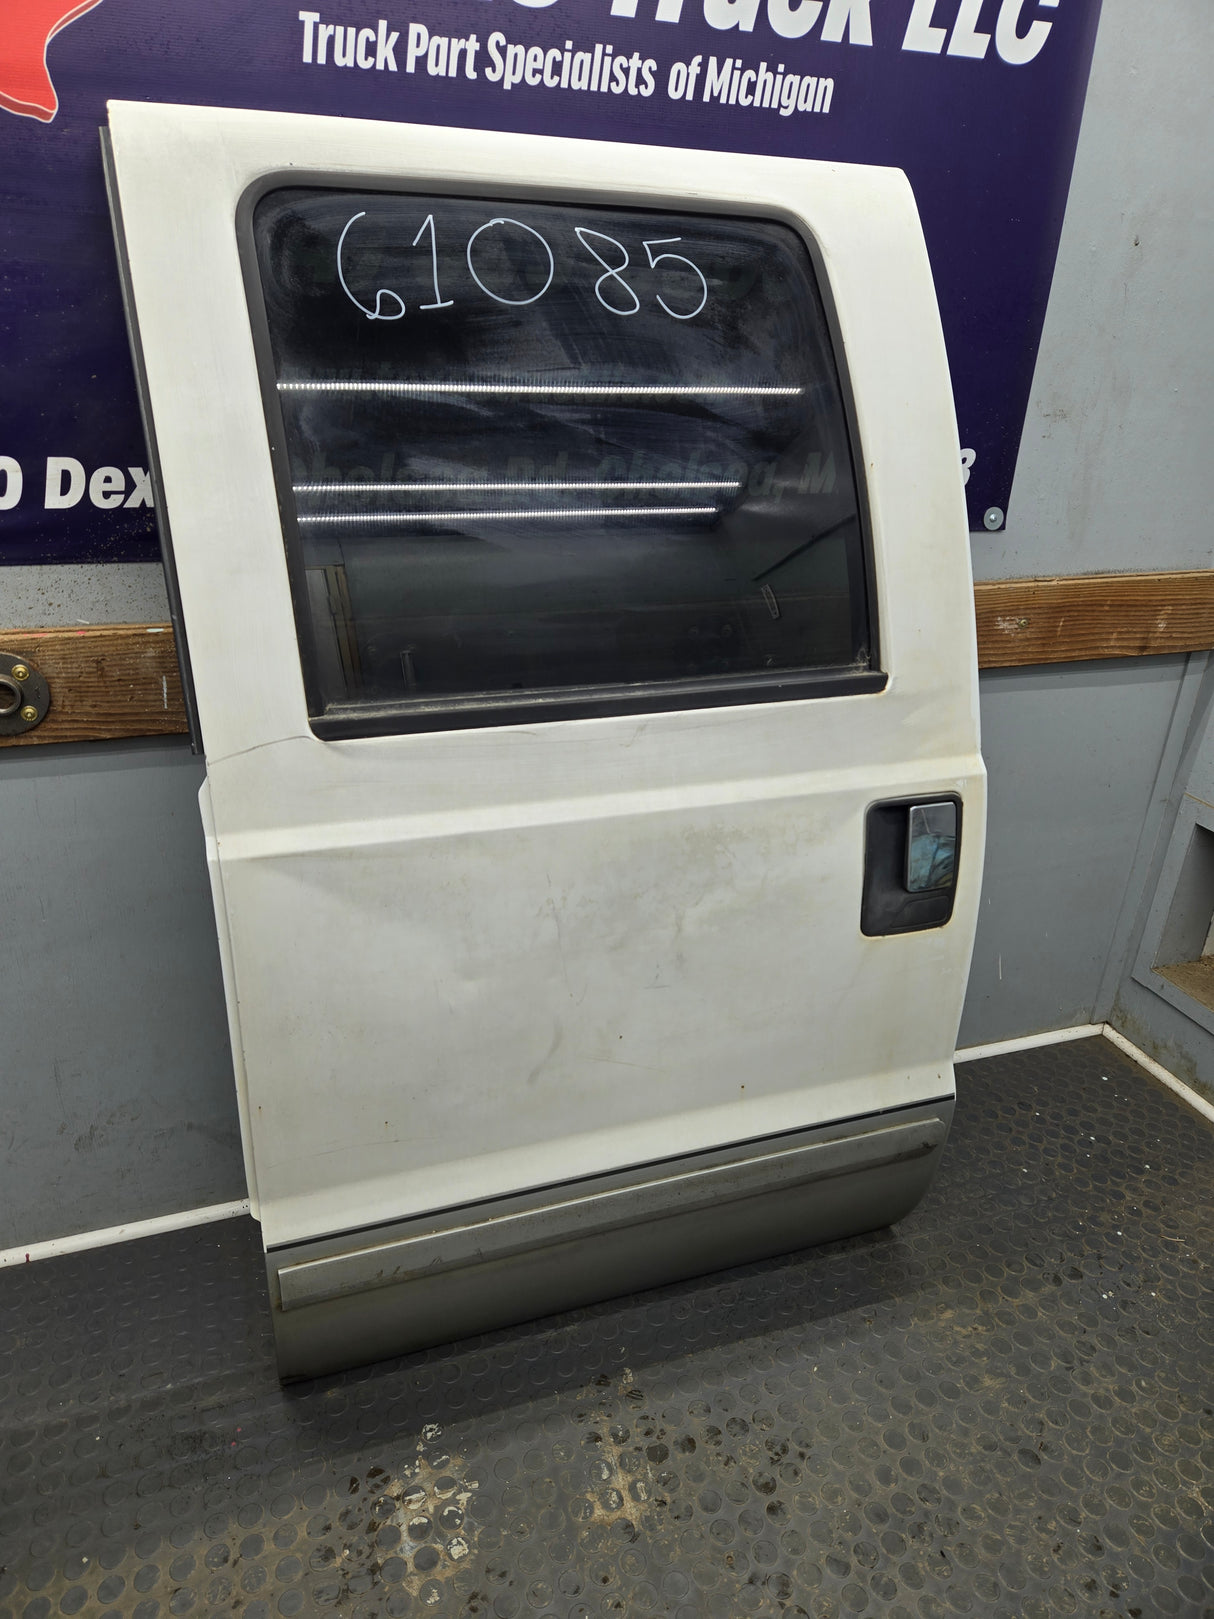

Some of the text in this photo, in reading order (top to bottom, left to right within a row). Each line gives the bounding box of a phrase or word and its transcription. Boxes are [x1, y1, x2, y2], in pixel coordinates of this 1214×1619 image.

[299, 11, 835, 116] Truck Part Specialists of Michigan
